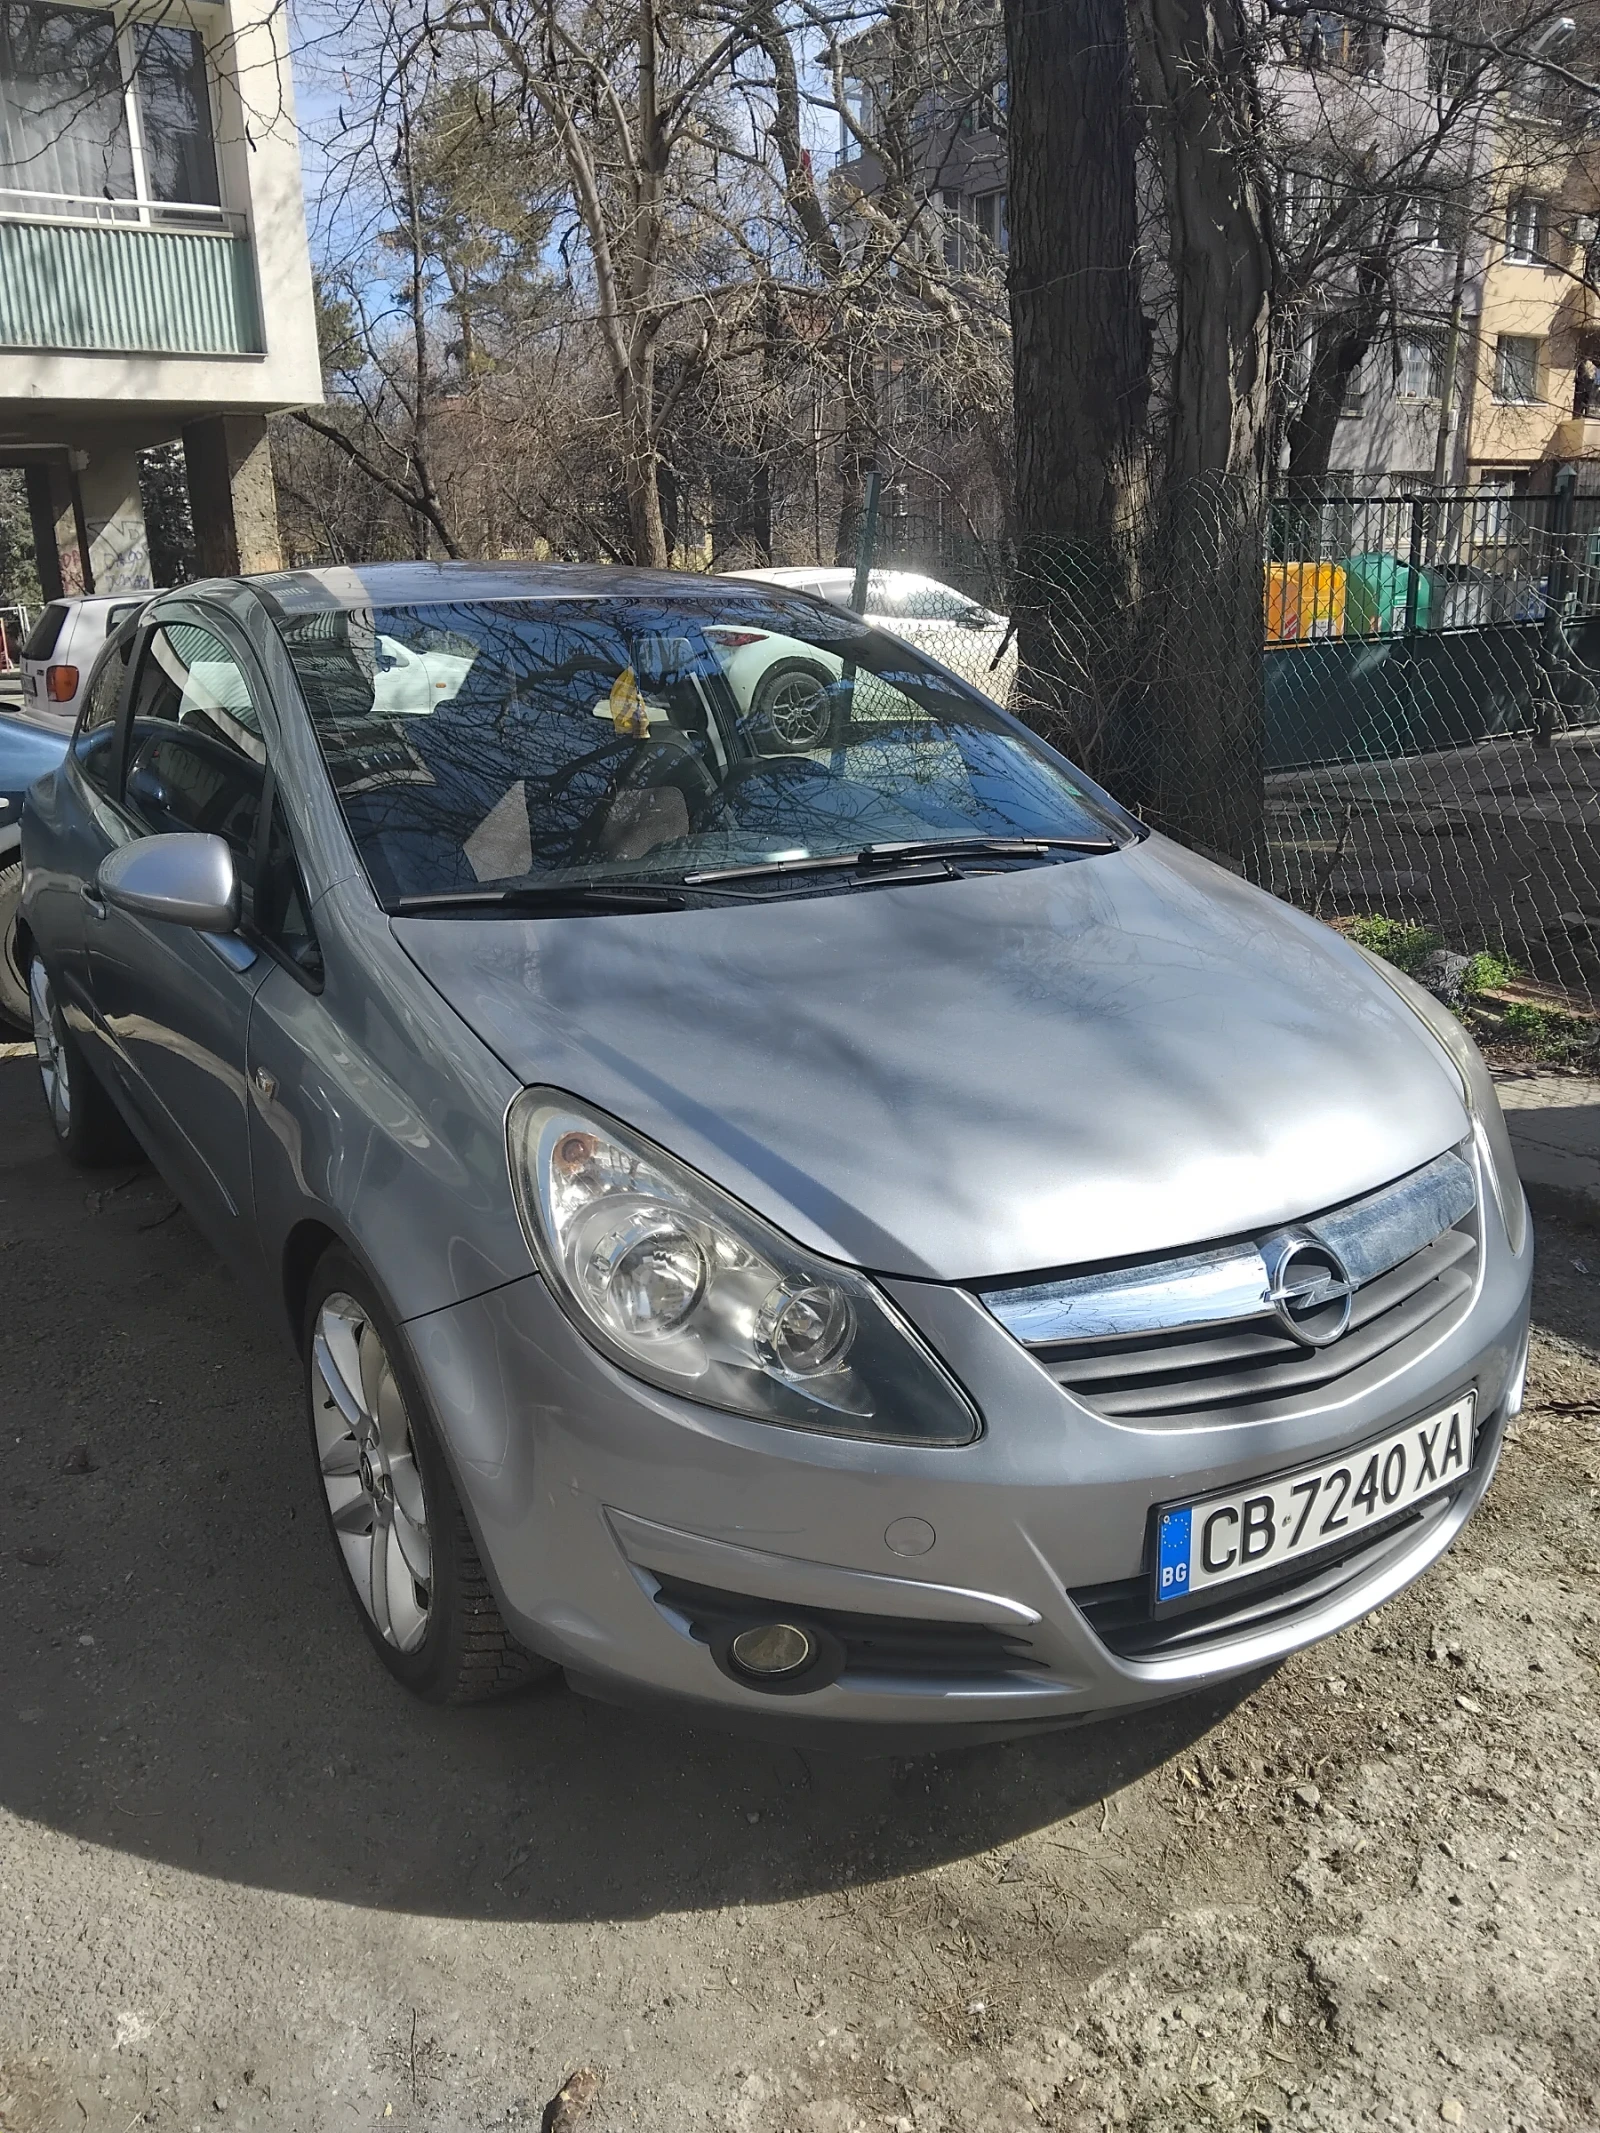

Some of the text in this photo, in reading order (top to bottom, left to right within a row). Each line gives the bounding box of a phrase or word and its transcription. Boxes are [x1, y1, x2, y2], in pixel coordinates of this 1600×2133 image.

[1201, 1412, 1463, 1575] CB 7240 XA
[1162, 1562, 1187, 1588] BG
